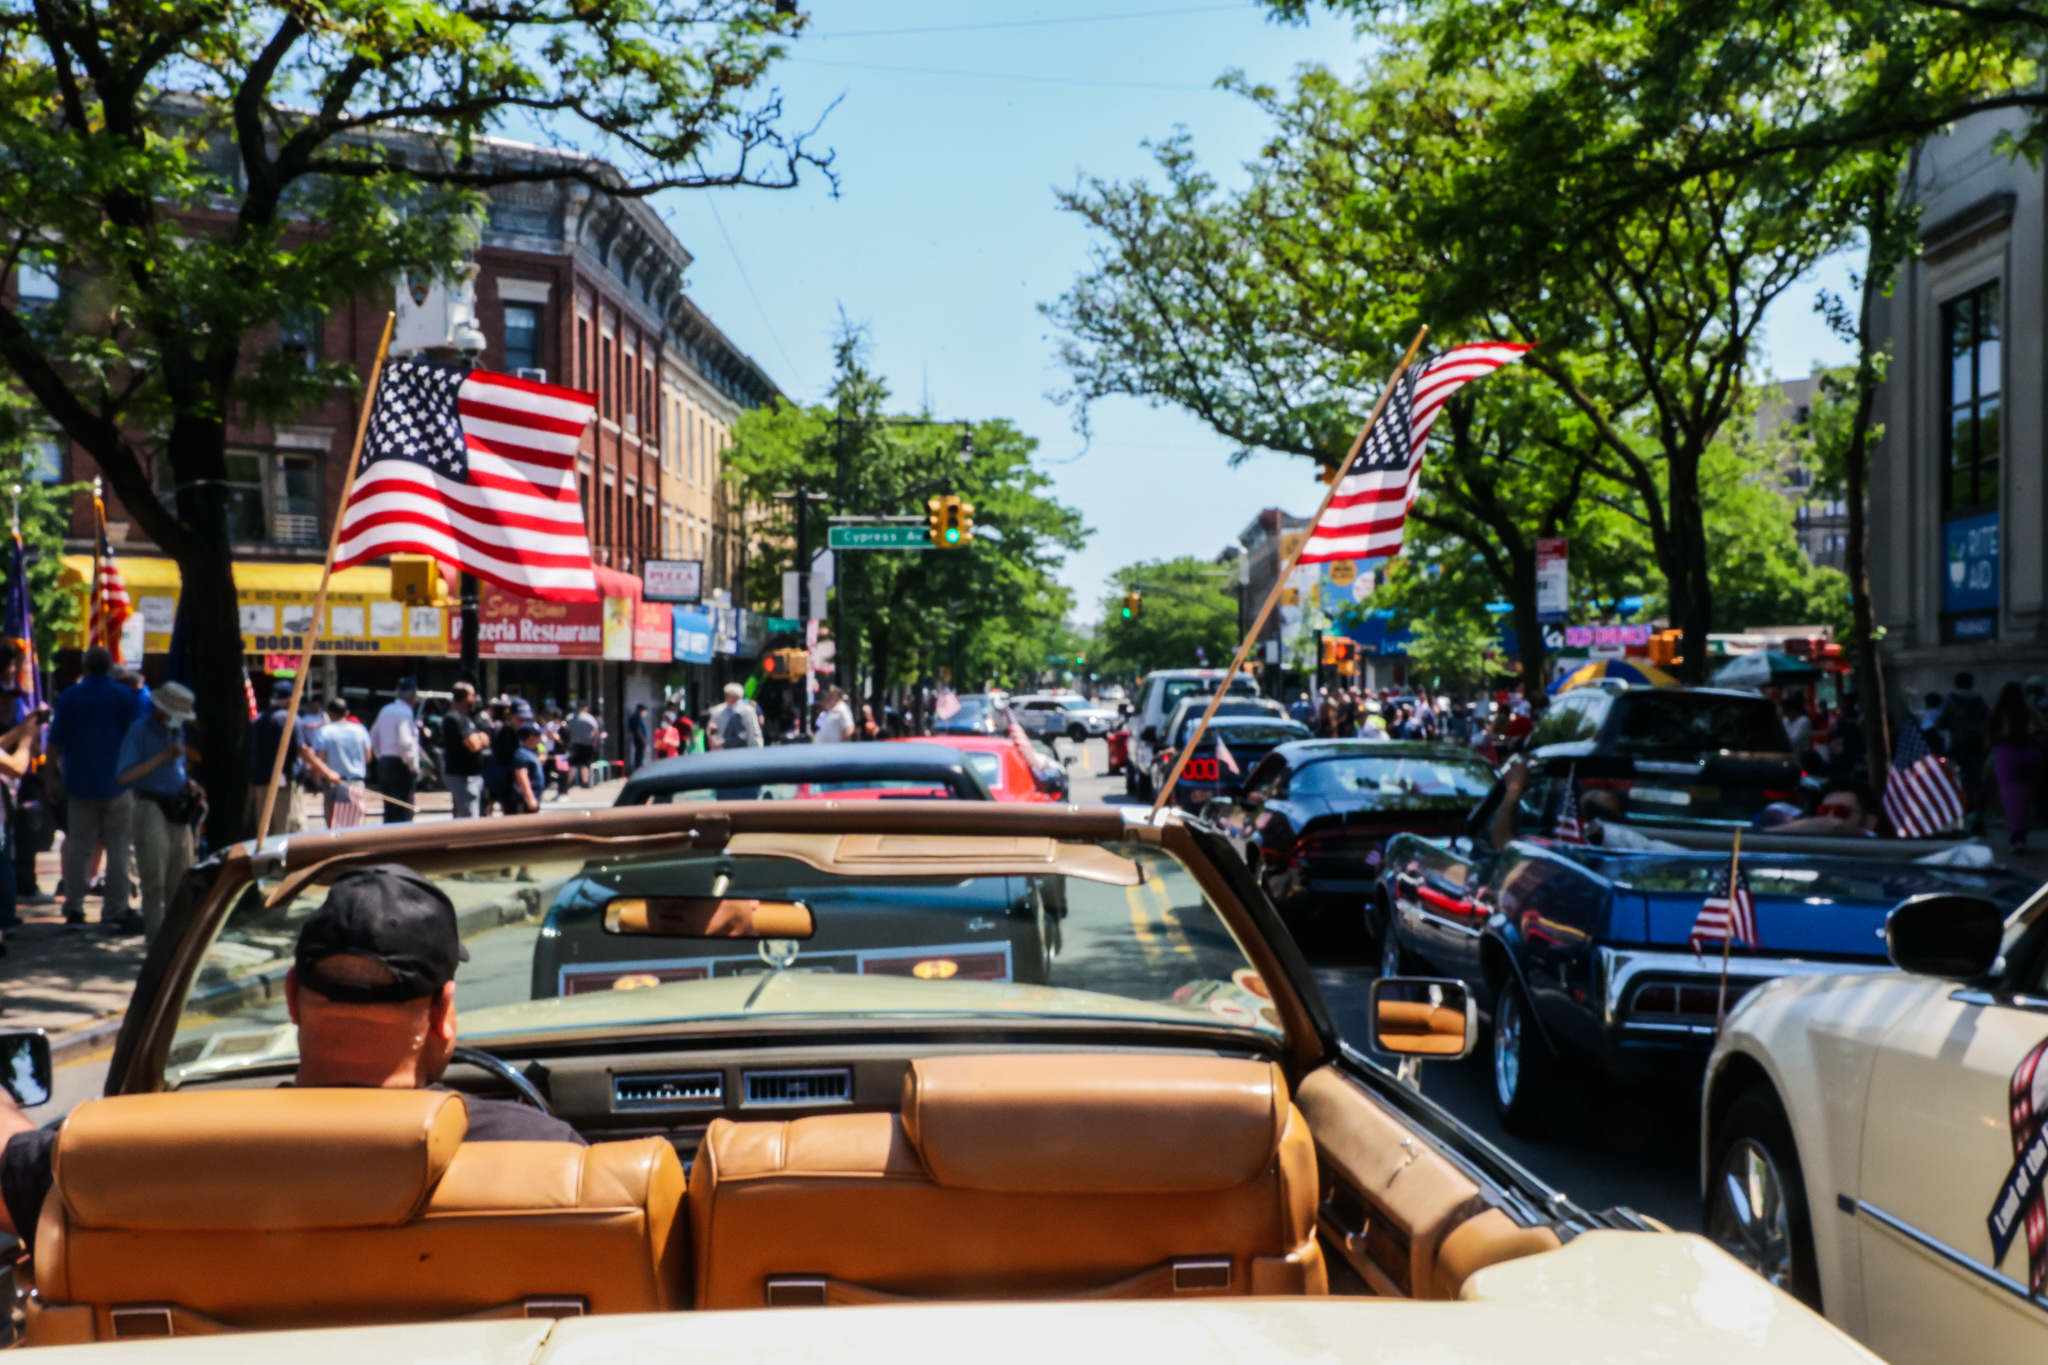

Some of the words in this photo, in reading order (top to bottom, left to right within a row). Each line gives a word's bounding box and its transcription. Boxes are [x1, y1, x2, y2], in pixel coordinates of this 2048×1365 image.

[844, 530, 897, 546] Cypress
[649, 571, 694, 582] PIZZA
[1968, 559, 1992, 591] AID
[486, 596, 519, 618] San
[451, 616, 518, 642] Pzeria
[520, 617, 601, 643] Restaurant
